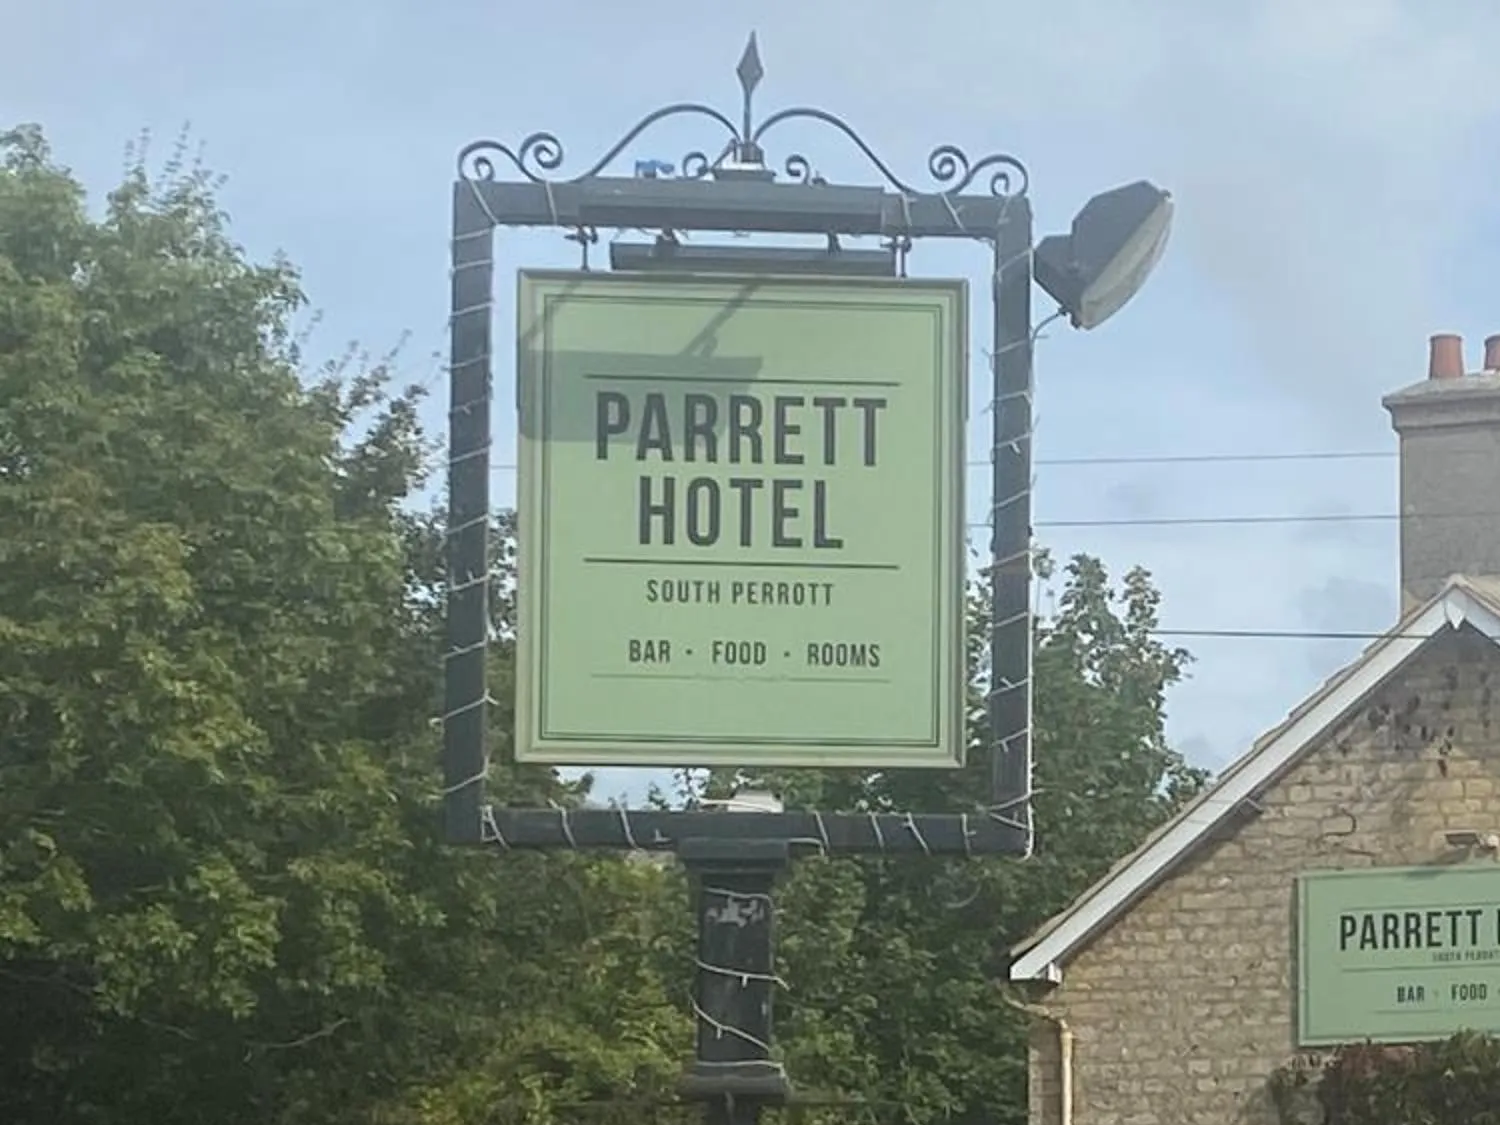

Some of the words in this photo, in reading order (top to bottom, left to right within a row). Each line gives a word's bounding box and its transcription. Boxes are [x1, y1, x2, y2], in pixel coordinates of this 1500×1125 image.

[596, 390, 887, 466] PARRETT
[638, 475, 844, 549] HOTEL
[646, 579, 721, 604] SOUTH
[731, 581, 834, 606] PERROTT
[628, 640, 671, 664] BAR
[711, 641, 767, 666] FOOD
[807, 643, 881, 668] ROOMS
[1339, 909, 1483, 951] PARRETT
[1397, 985, 1425, 1003] BAR
[1451, 983, 1487, 1001] FOOD
